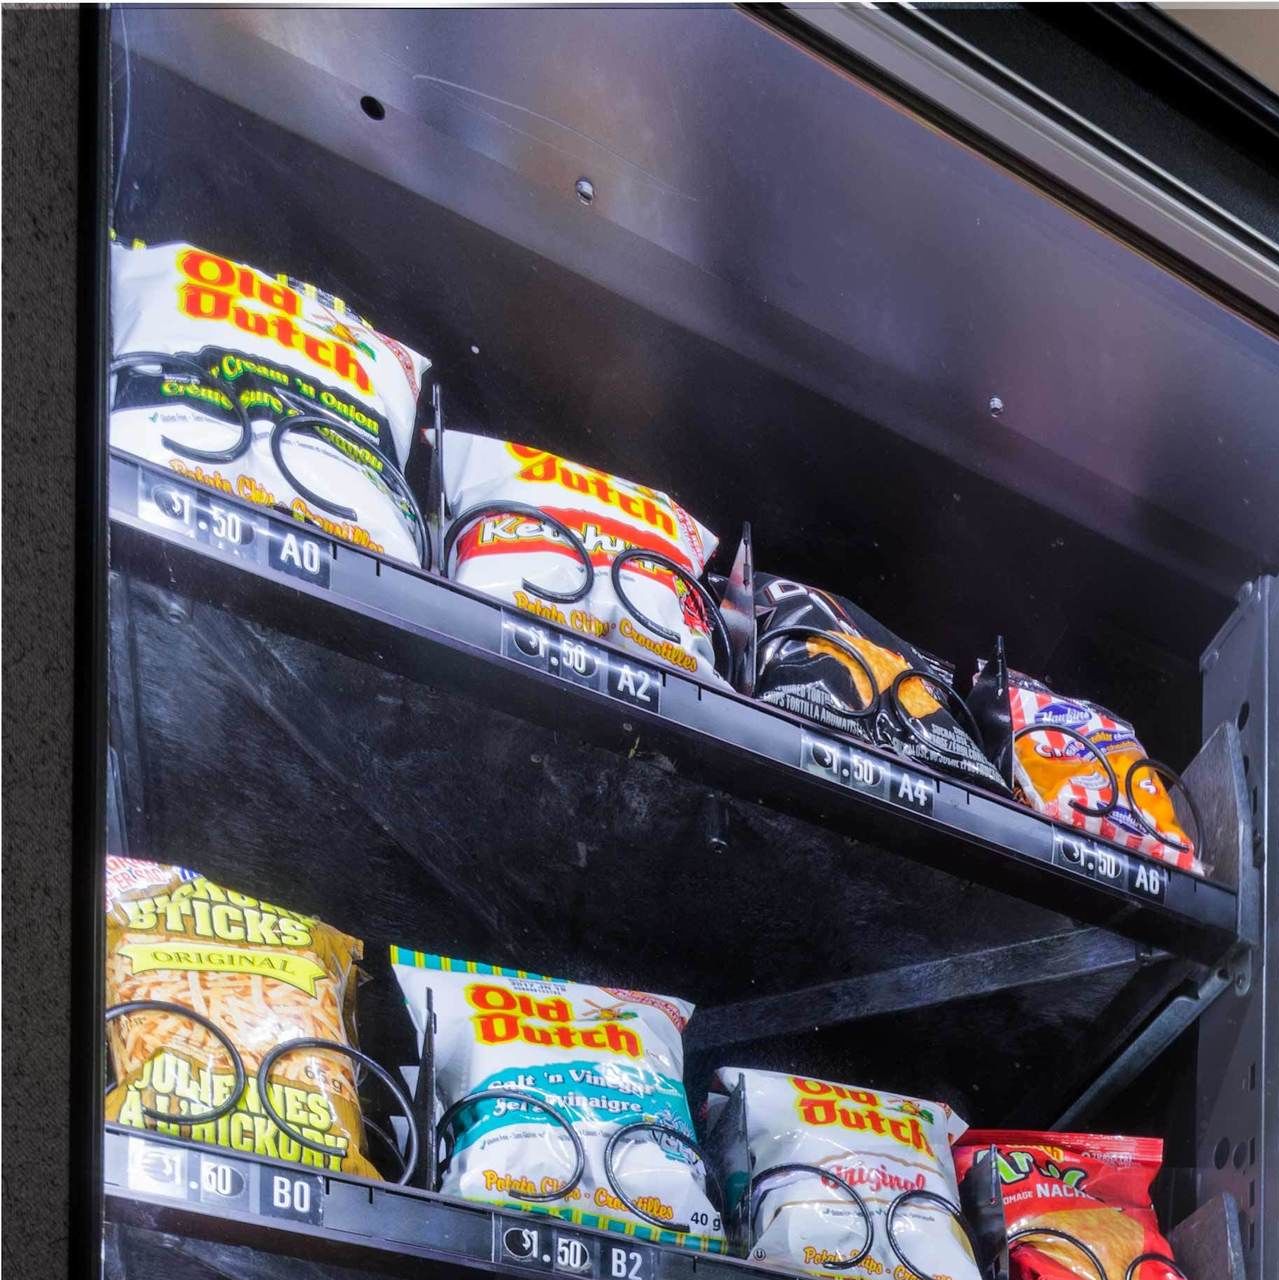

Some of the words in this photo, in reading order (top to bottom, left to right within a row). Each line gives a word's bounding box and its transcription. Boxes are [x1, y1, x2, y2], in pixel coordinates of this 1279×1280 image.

[177, 249, 303, 318] Old
[177, 283, 375, 396] Dutch
[221, 355, 290, 385] Cream
[319, 390, 380, 435] Onion
[512, 450, 679, 541] Dutch
[279, 532, 321, 575] A0
[618, 619, 698, 672] Croustilles
[617, 665, 651, 700] A2
[898, 774, 929, 807] A4
[1135, 863, 1160, 895] A6
[128, 896, 314, 947] STICKS
[153, 950, 296, 974] ORIGINAL
[467, 983, 573, 1023] Old
[474, 1014, 644, 1060] Dutch
[789, 1075, 880, 1108] Old
[792, 1097, 937, 1161] Dutch
[272, 1176, 312, 1213] B0
[483, 1170, 536, 1196] Potato
[821, 1162, 927, 1192] Original
[691, 1211, 710, 1226] 40
[712, 1215, 722, 1230] g
